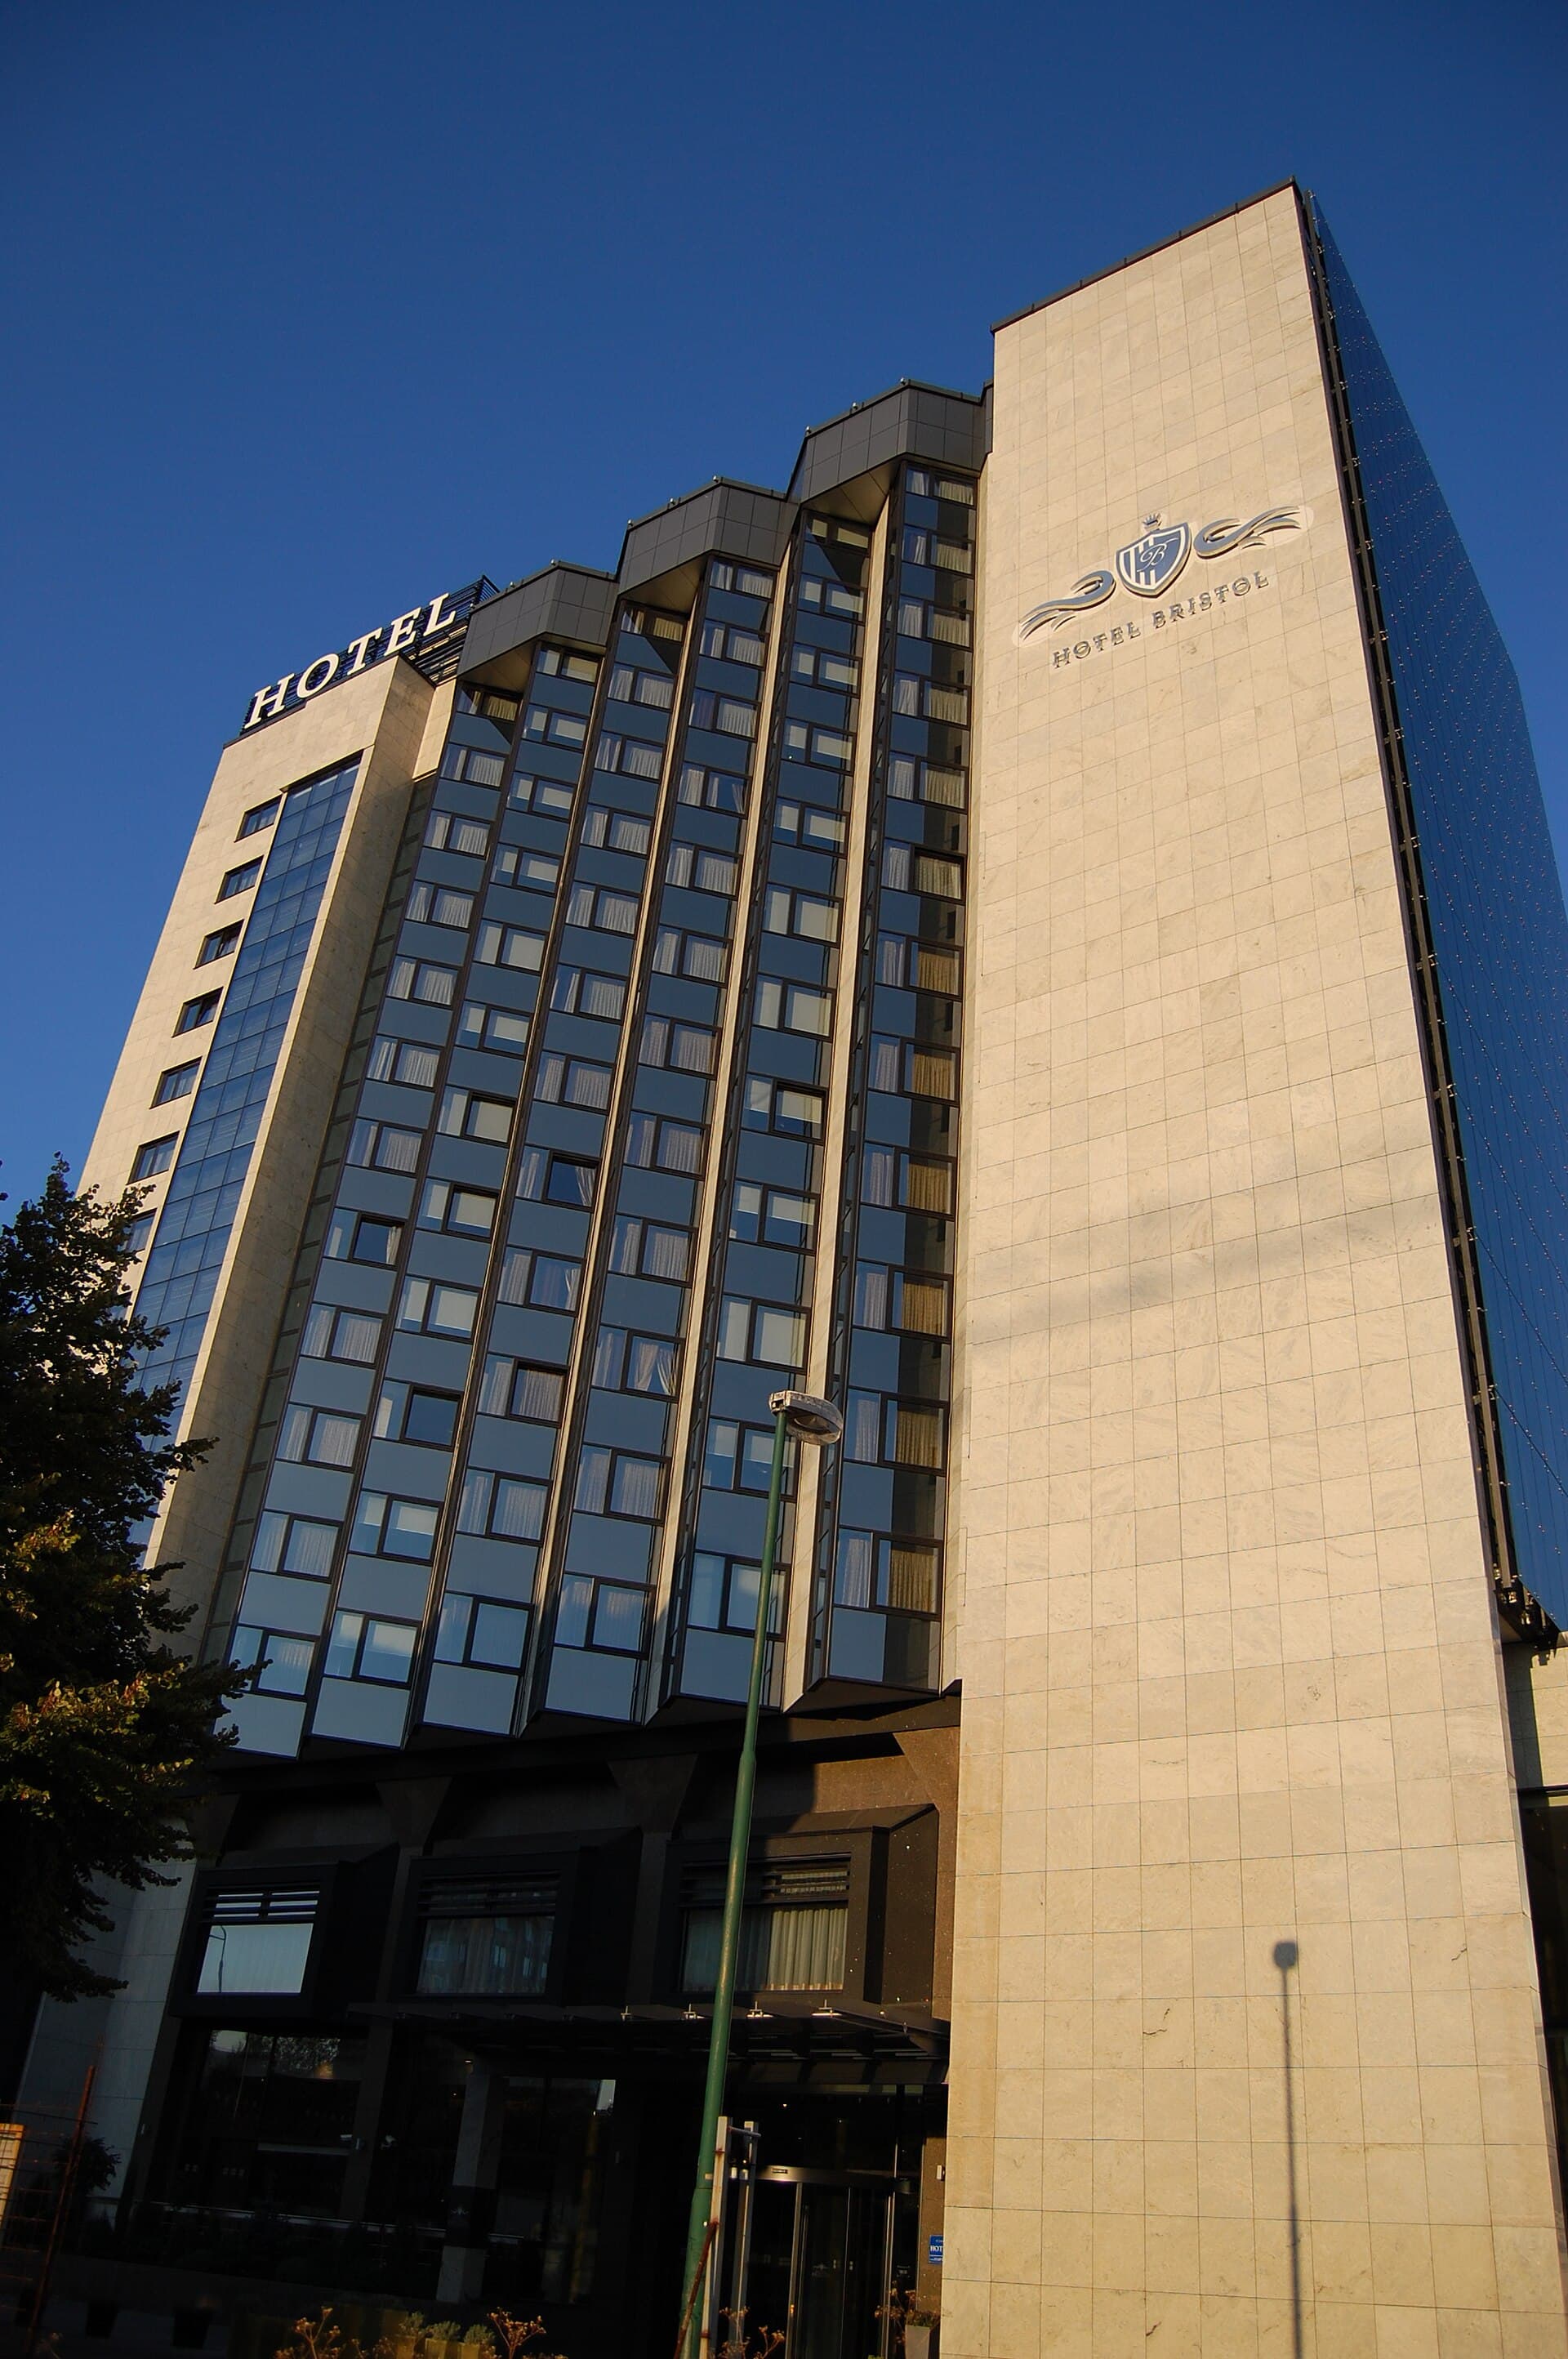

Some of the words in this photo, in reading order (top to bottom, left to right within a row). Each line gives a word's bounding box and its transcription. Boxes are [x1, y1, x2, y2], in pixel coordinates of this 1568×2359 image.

[244, 592, 457, 729] HOTEL
[1053, 621, 1142, 668] HOTEL
[1152, 570, 1270, 629] BRISTOL
